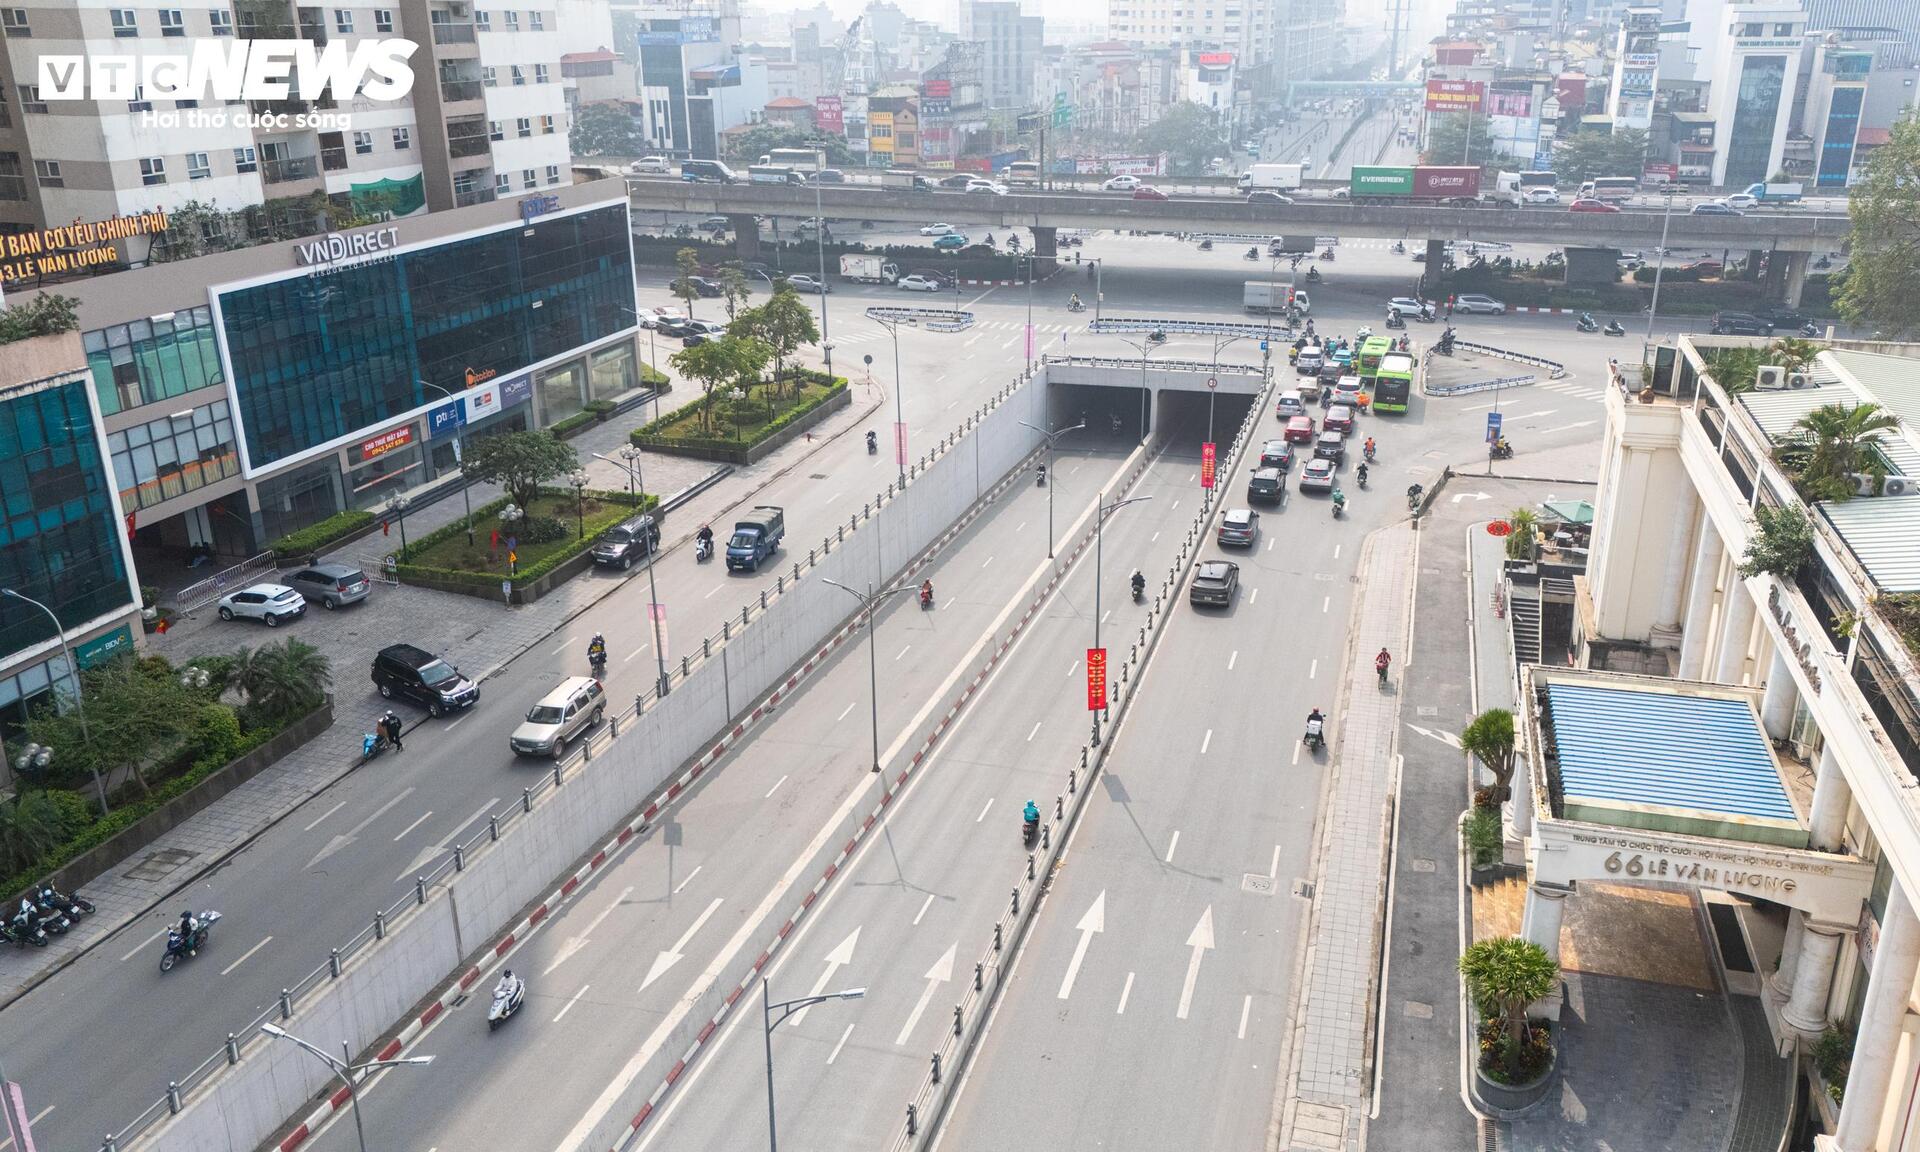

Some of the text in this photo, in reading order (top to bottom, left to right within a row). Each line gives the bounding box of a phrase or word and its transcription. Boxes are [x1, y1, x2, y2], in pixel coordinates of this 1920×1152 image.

[8, 232, 42, 257] BAN
[44, 228, 65, 250] CƠ
[300, 227, 398, 265] VNDIRECT
[17, 257, 36, 278] LÊ
[37, 253, 67, 274] VĂN
[70, 246, 117, 268] LƯƠNG
[1573, 834, 1598, 844] TRUNG
[1600, 837, 1615, 847] TÂM
[1616, 838, 1628, 848] TỔ
[1629, 842, 1651, 850] CHỨC
[1604, 851, 1798, 893] 66 LÊ VĂN LƯƠNG
